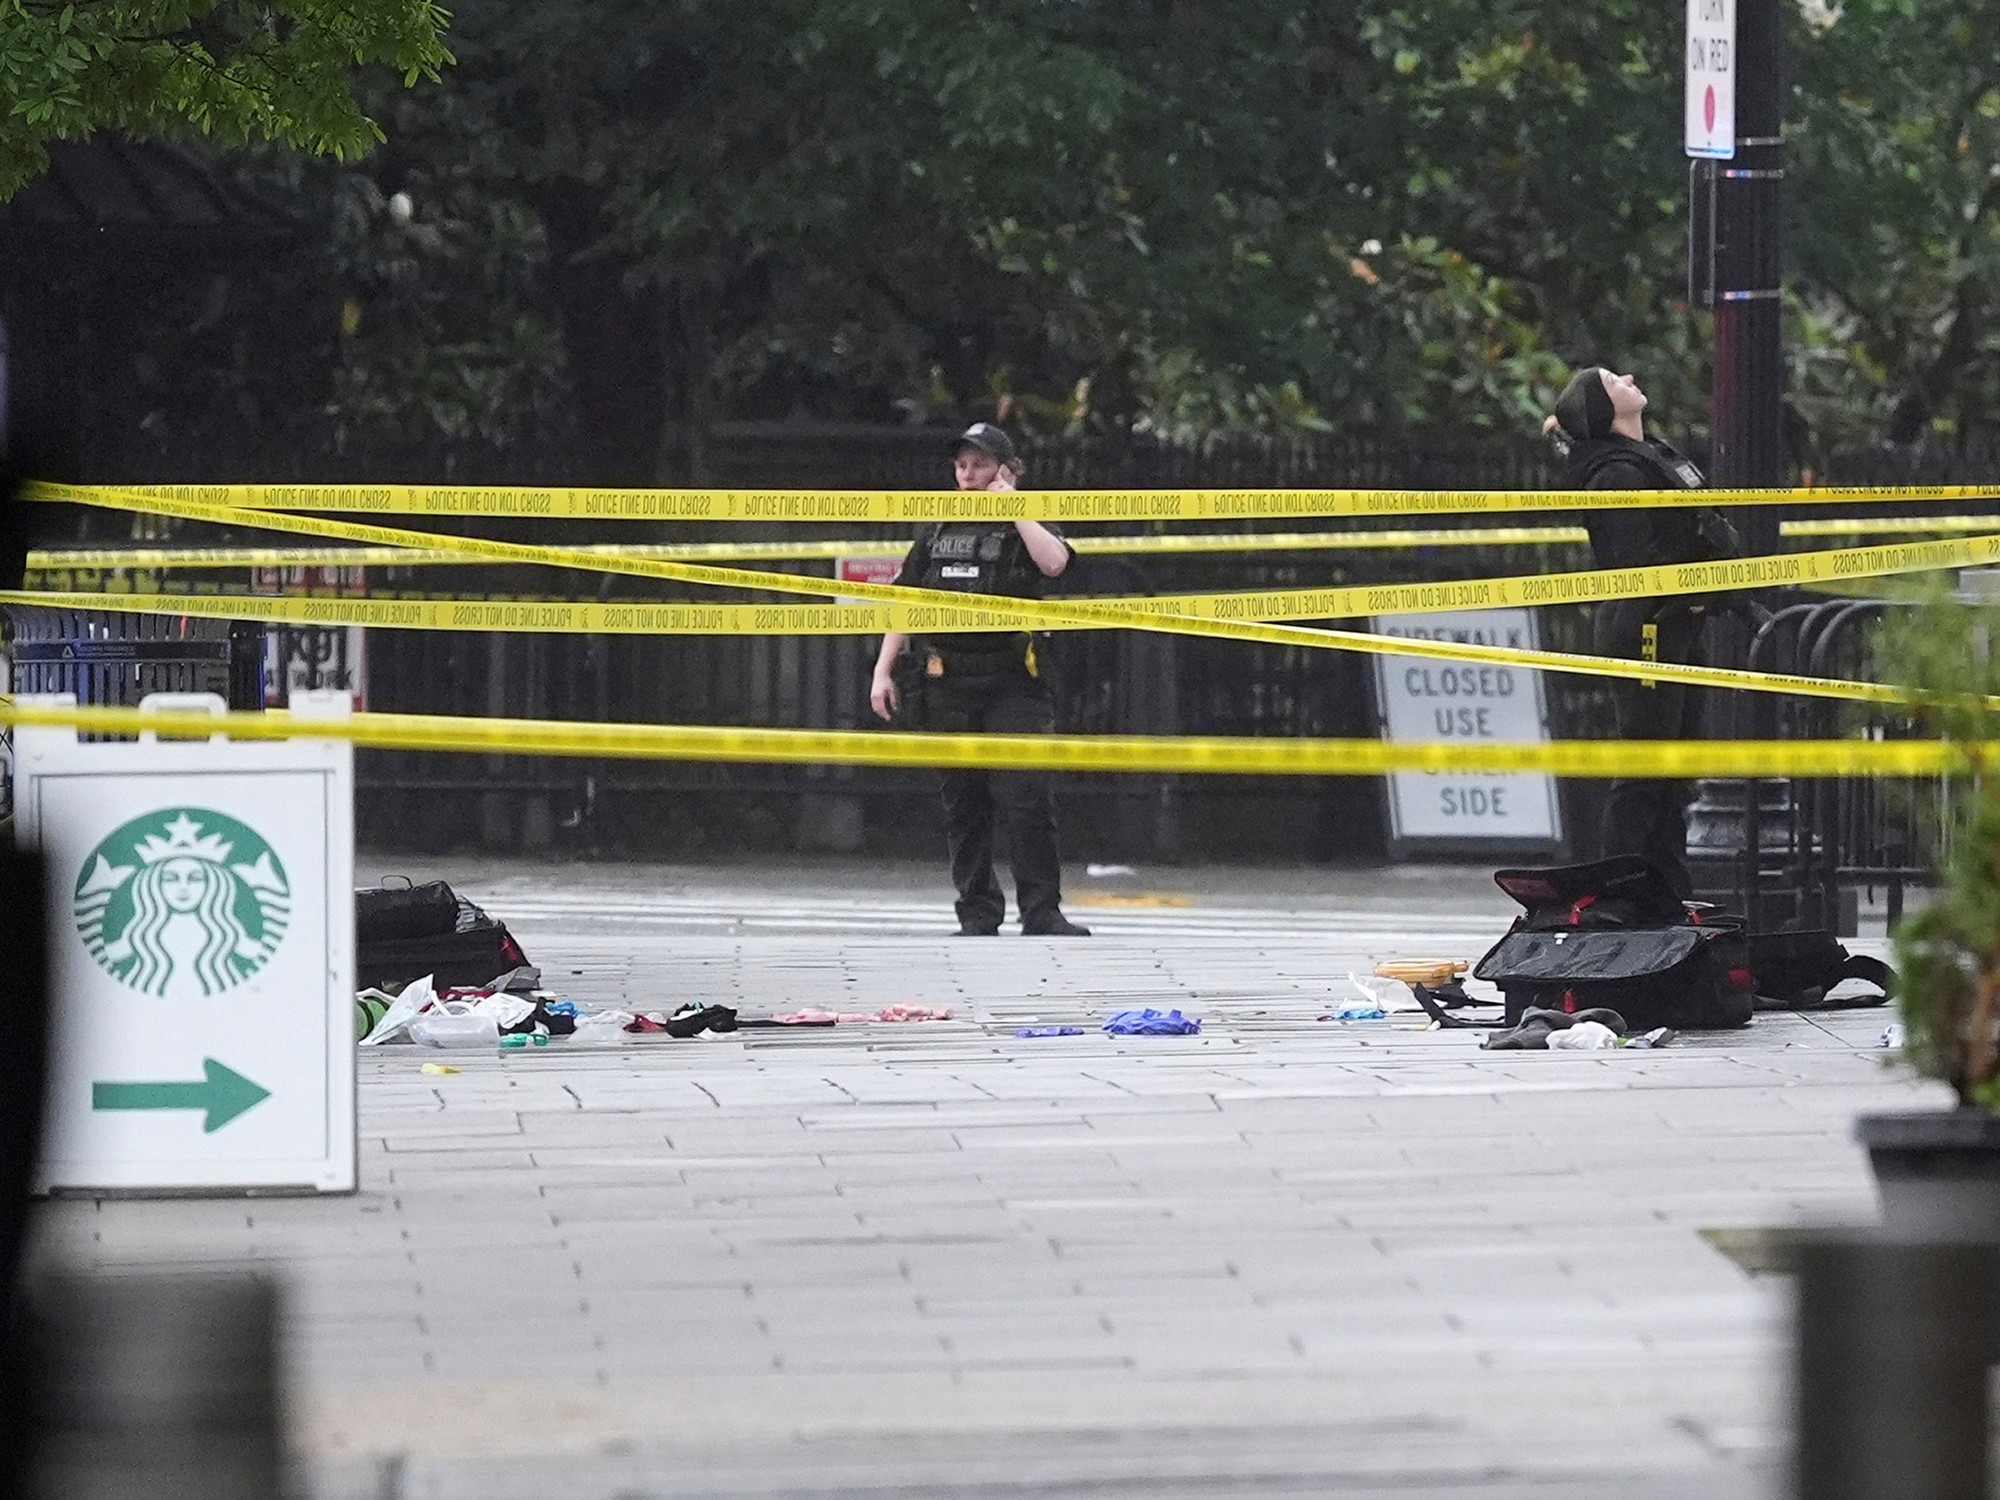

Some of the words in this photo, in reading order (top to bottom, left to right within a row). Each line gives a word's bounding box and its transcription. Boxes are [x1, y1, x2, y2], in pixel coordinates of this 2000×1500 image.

[1709, 38, 1729, 72] RED
[932, 538, 973, 553] POLICE
[1405, 667, 1515, 697] CLOSED
[1434, 707, 1492, 736] USE
[1441, 787, 1507, 816] SIDE
